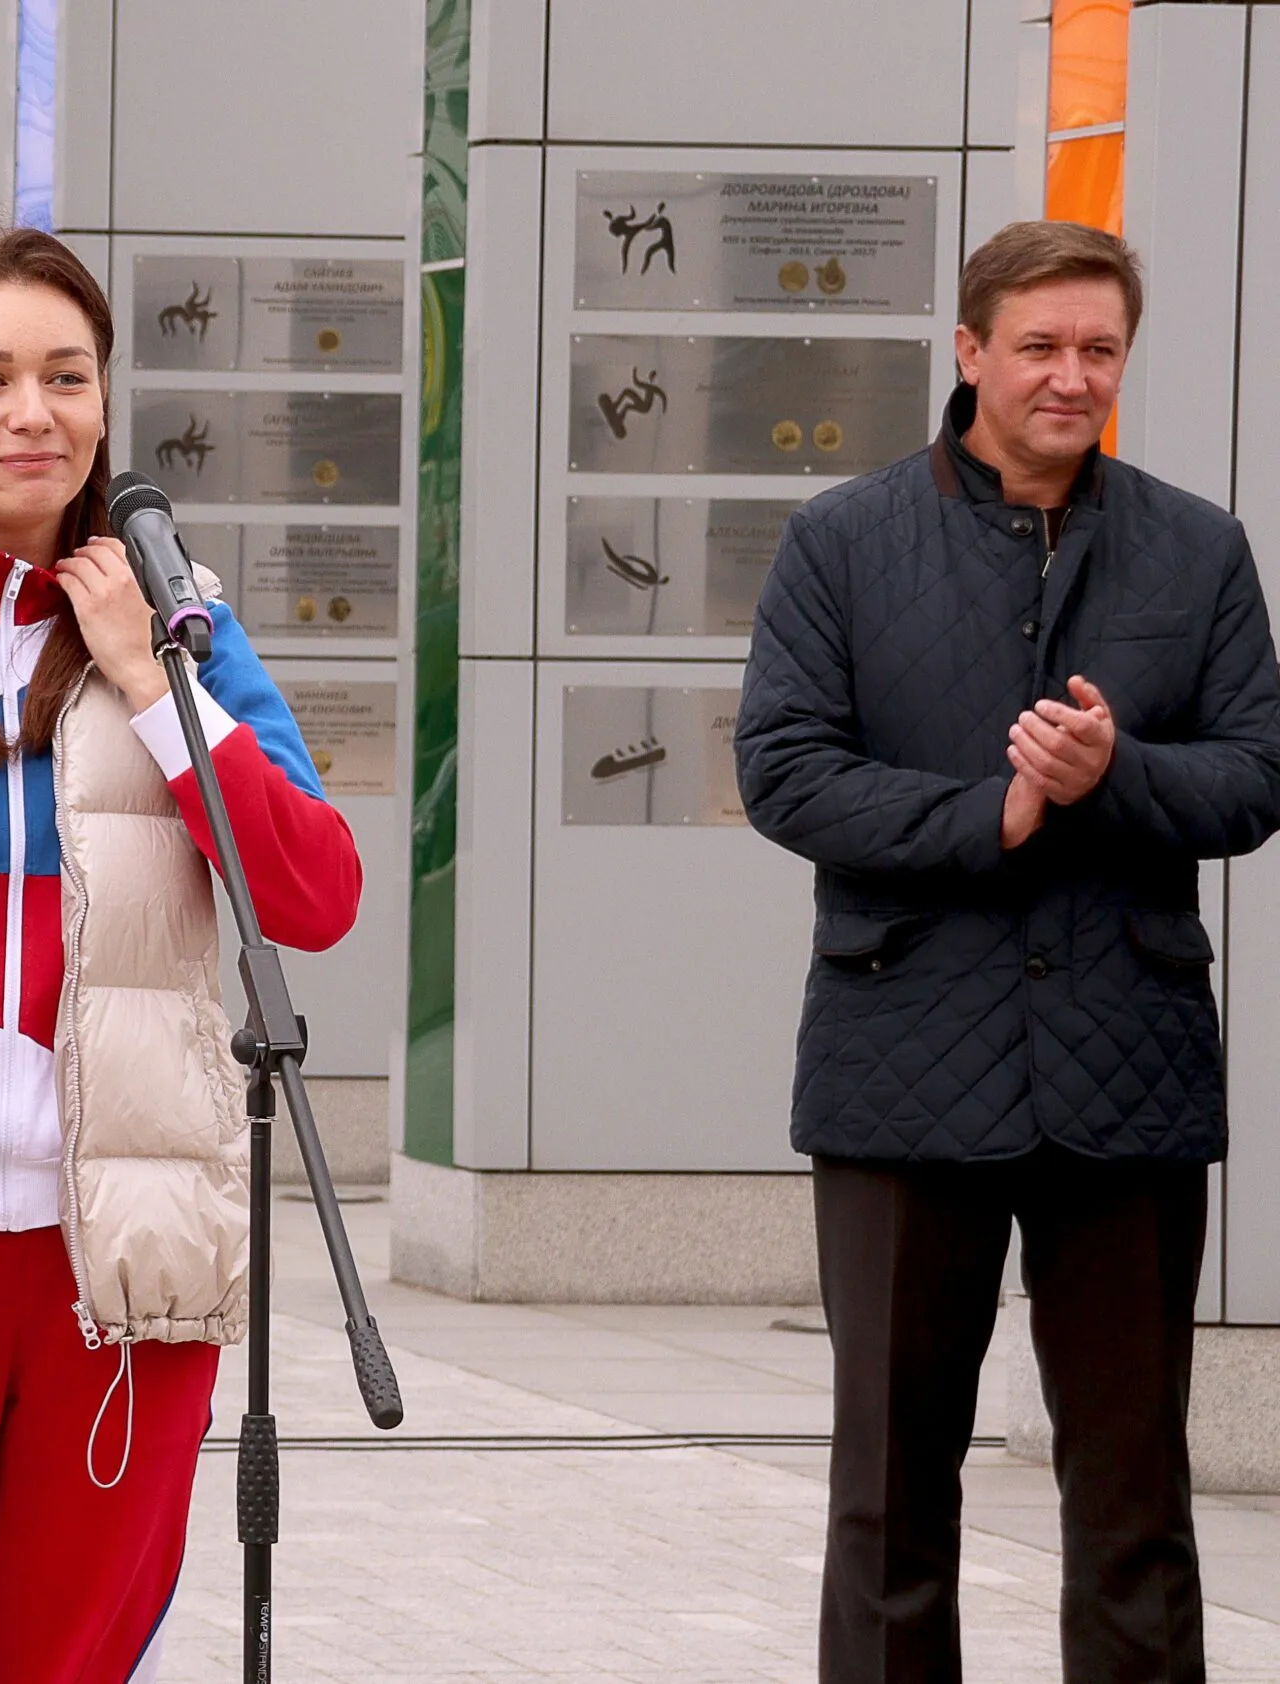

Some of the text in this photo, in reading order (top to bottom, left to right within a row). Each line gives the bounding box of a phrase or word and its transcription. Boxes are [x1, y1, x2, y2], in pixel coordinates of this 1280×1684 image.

[720, 183, 911, 199] ДОБРОВИДОВА (ДРОЗДОВА)
[747, 201, 879, 214] МАРИНА ИГОРЕВНА
